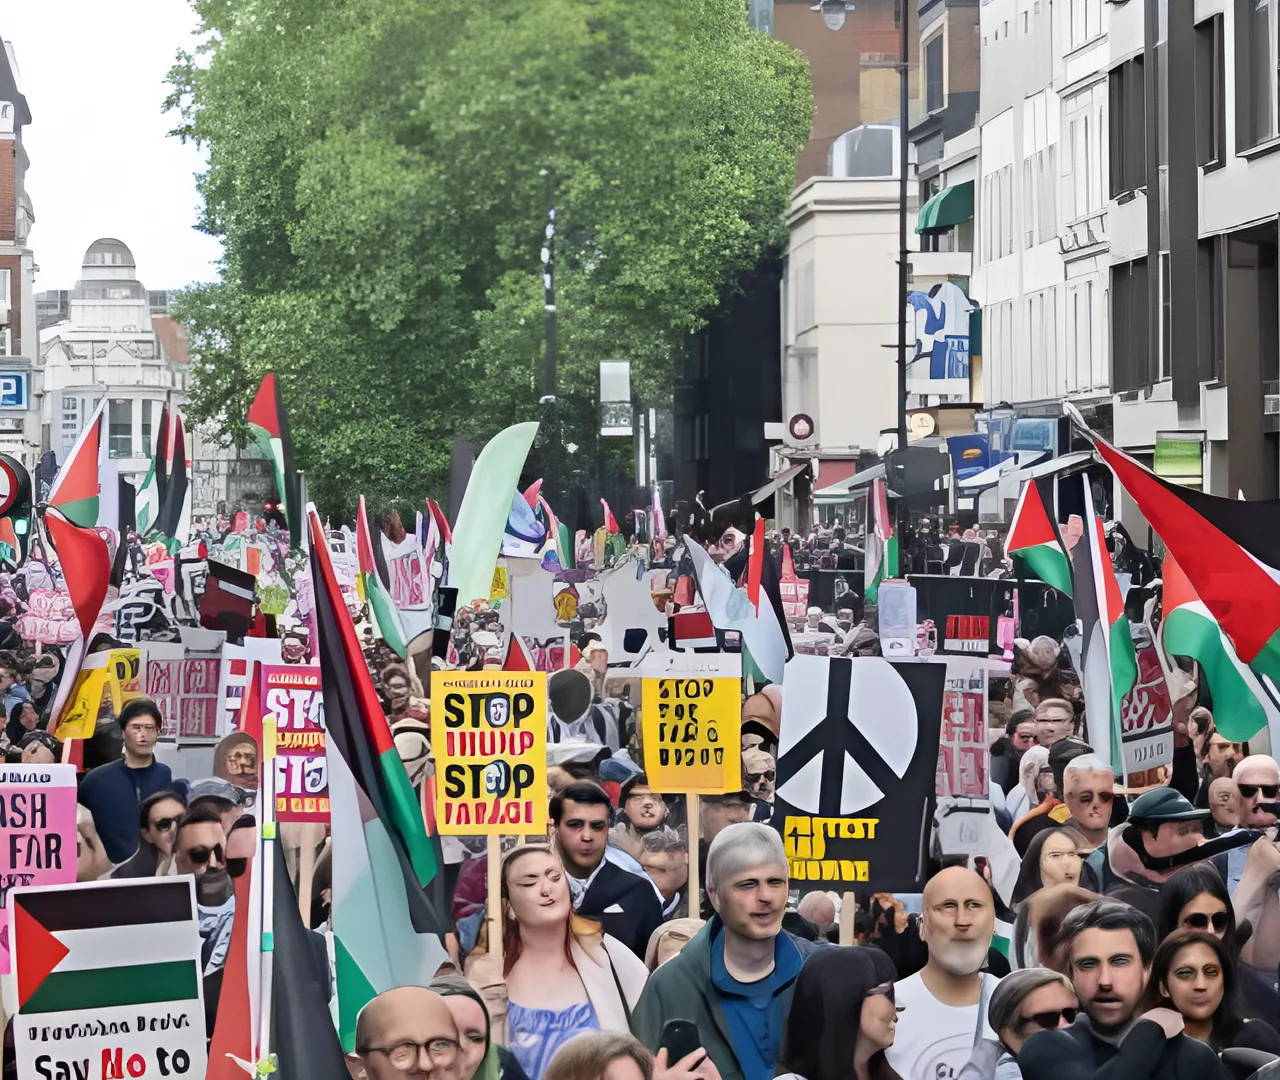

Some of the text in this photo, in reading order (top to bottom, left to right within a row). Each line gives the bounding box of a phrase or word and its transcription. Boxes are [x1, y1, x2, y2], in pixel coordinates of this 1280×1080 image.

[445, 692, 535, 728] STOP
[445, 760, 535, 799] STOP
[10, 833, 62, 869] FAR
[101, 1047, 146, 1080] No
[156, 1047, 191, 1076] to
